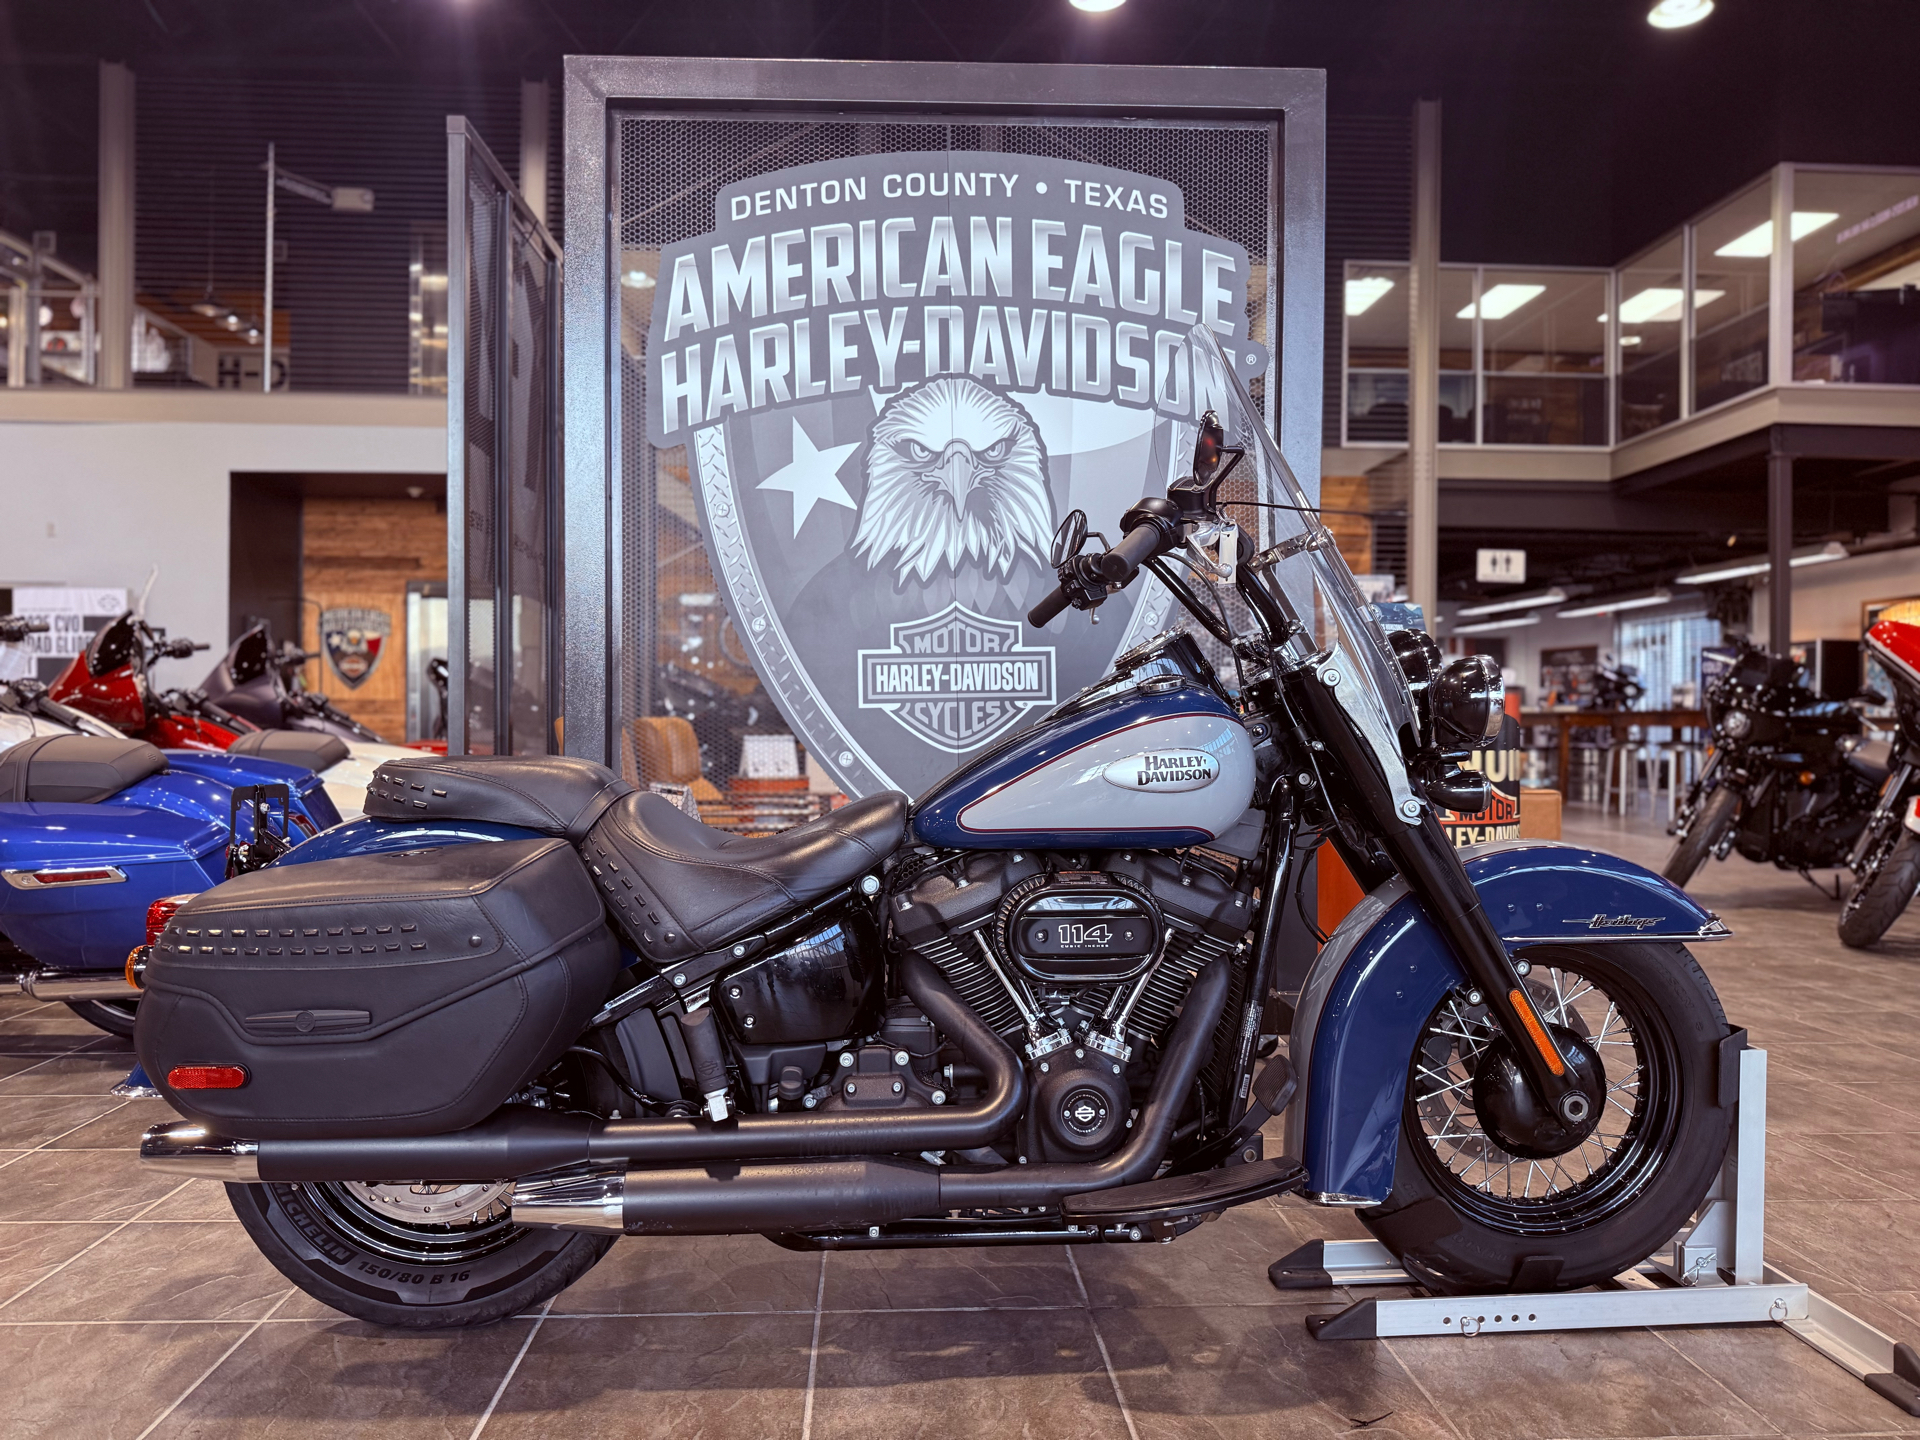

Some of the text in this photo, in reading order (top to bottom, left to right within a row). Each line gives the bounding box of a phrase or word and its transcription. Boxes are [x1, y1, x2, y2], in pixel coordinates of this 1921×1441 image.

[731, 172, 1169, 221] DENTON COUNTY TEXAS
[664, 216, 1236, 342] AMERICAN EAGLE
[661, 305, 1236, 434] HARLEY-DAVIDSON
[54, 614, 80, 632] CVO
[914, 620, 1000, 654] MOTOR
[26, 635, 52, 653] OAD
[875, 661, 1039, 693] HARLEY-DAVIDSON
[914, 701, 1002, 739] CYCLES
[1137, 768, 1212, 786] DAVIDSON
[1058, 924, 1113, 944] 114
[274, 1183, 351, 1260] MICHELIN
[357, 1260, 471, 1285] 150/80 B 16
